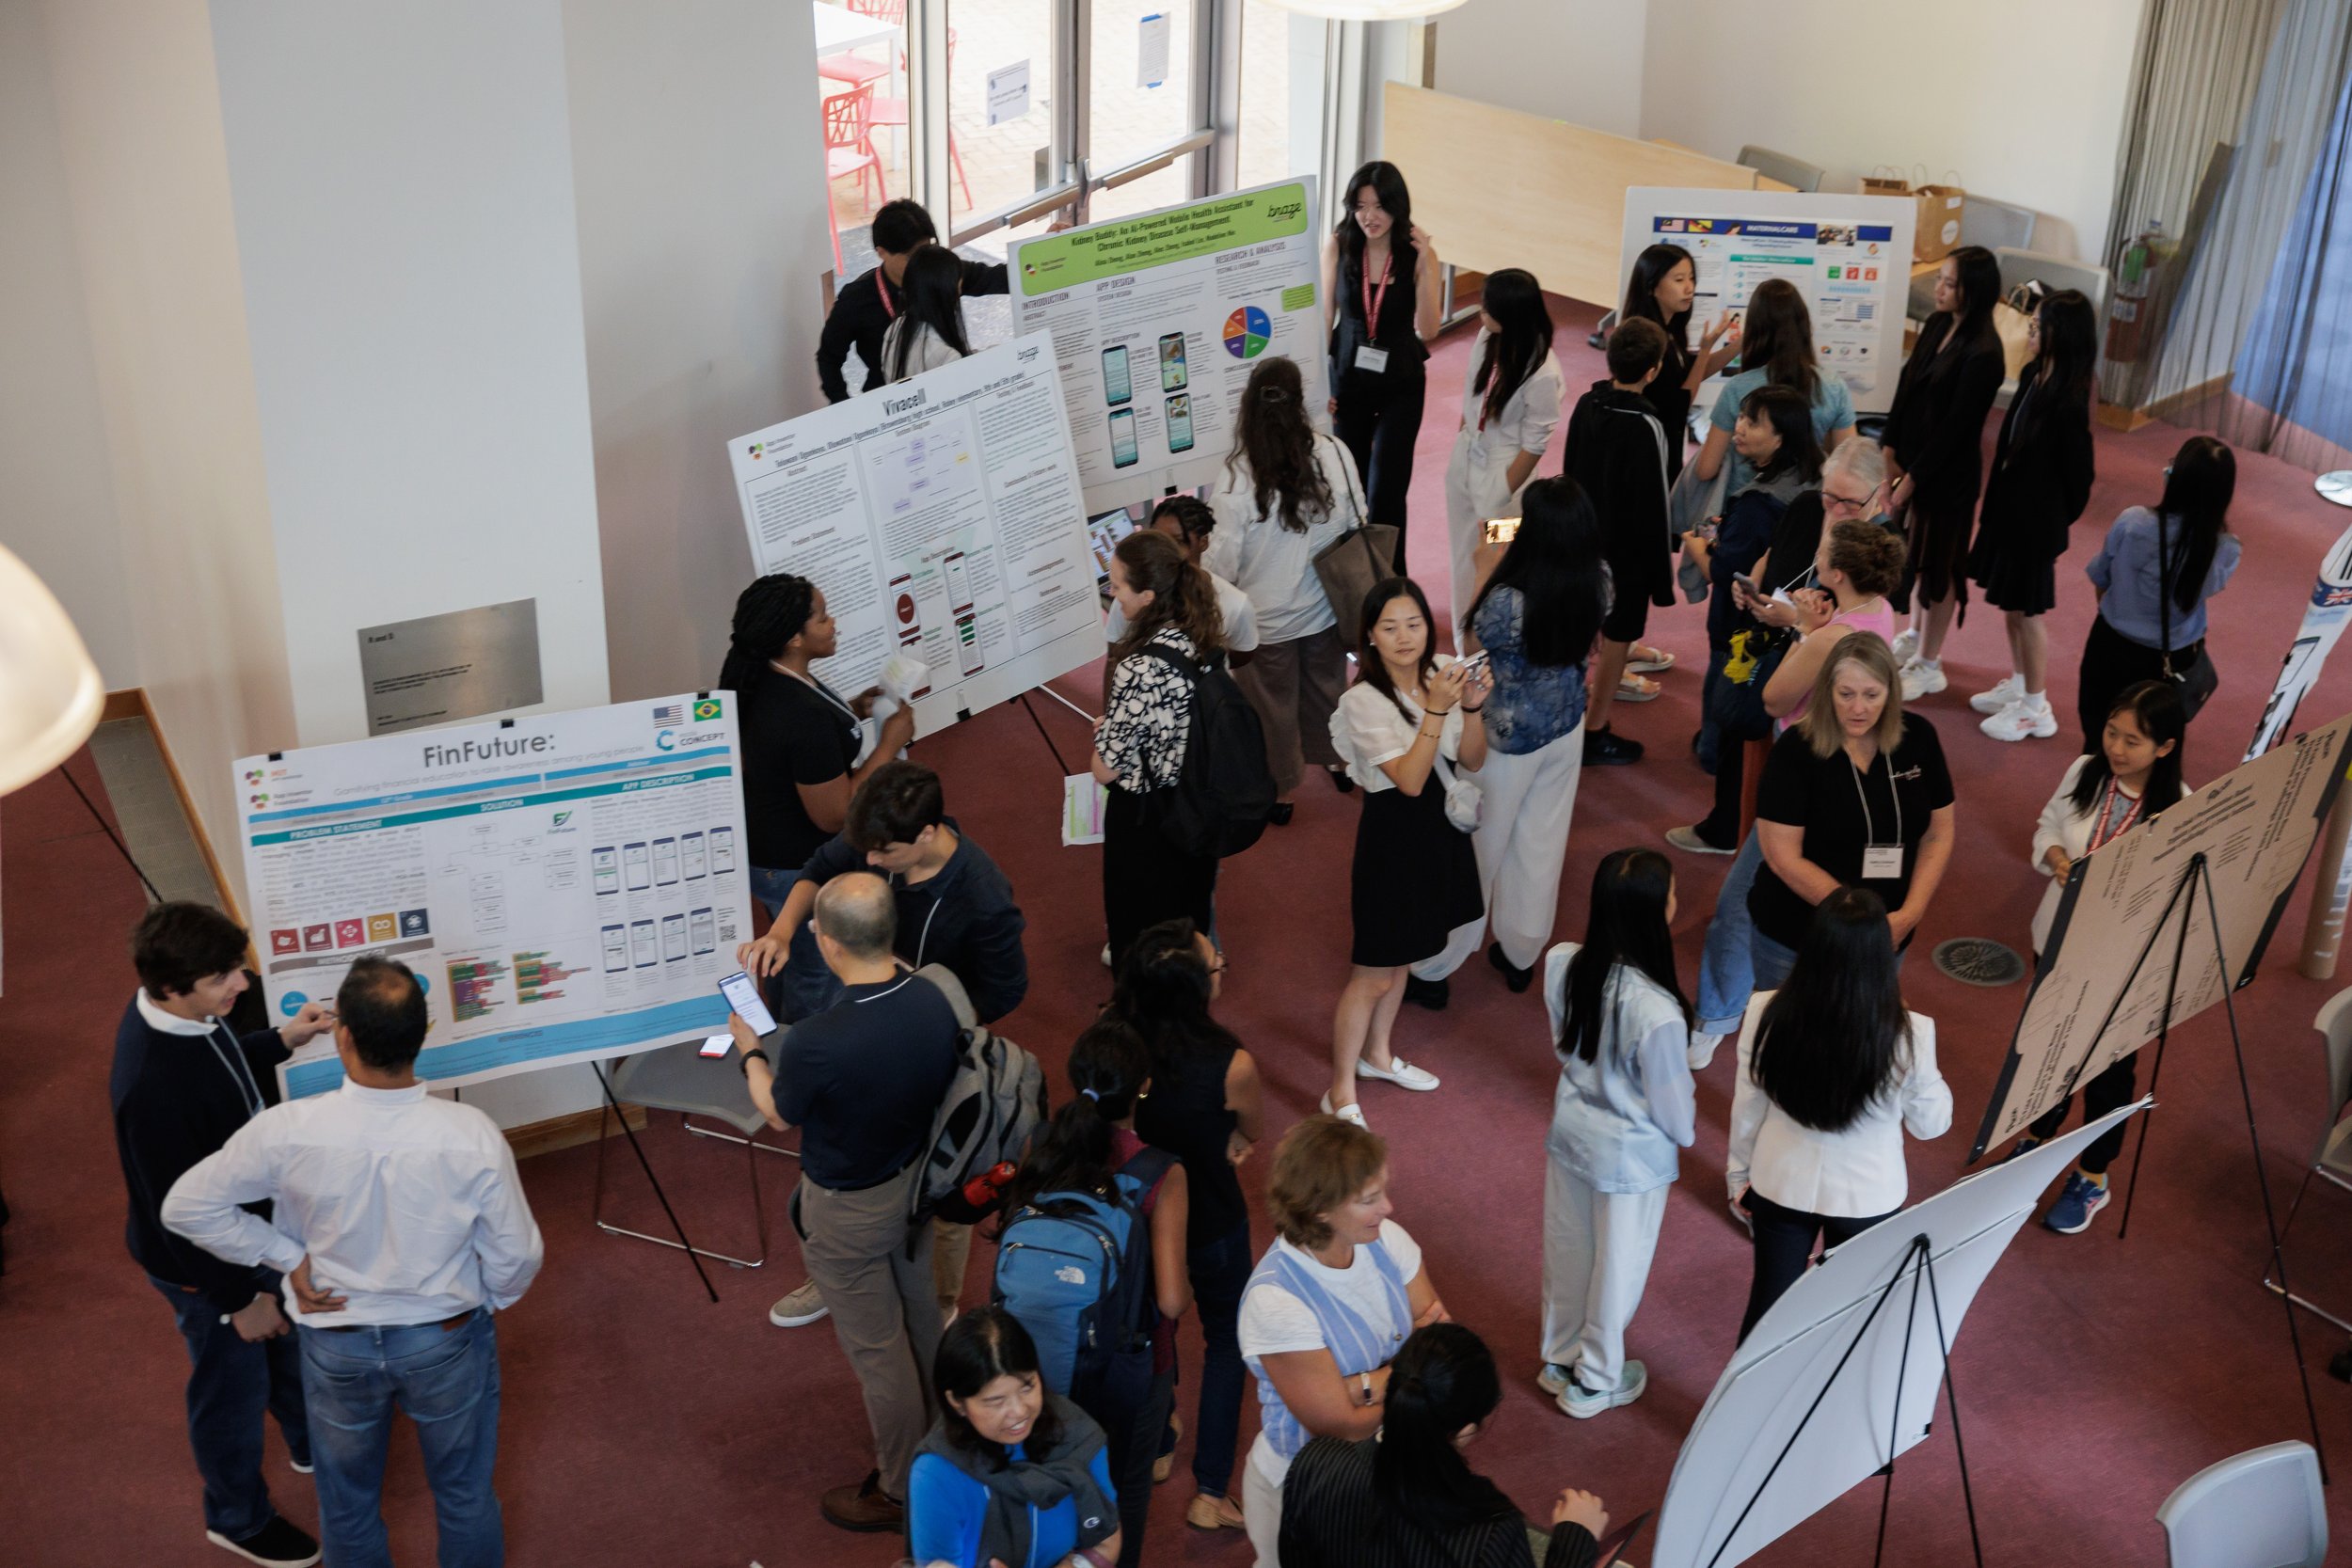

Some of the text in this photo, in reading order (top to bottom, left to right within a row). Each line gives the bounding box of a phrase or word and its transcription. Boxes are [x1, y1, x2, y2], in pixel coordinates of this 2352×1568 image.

[1266, 202, 1302, 220] braze
[1072, 236, 1093, 245] Kidney
[1095, 230, 1117, 241] Buddy:
[1191, 208, 1212, 219] Health
[1215, 201, 1243, 214] Assistant
[1097, 240, 1124, 252] Chronic
[1125, 234, 1147, 245] Kidney
[1149, 230, 1173, 241] Disease
[1215, 250, 1247, 264] RESEARCH
[1023, 292, 1070, 310] INTRODUCTION
[882, 388, 927, 416] Vivacell
[679, 732, 725, 746] CONCEPT
[423, 735, 556, 768] FinFuture:
[622, 773, 695, 792] APP DESCRIPTION
[480, 798, 524, 813] SOLUTION
[290, 819, 383, 840] PROBLEM STATEMENT
